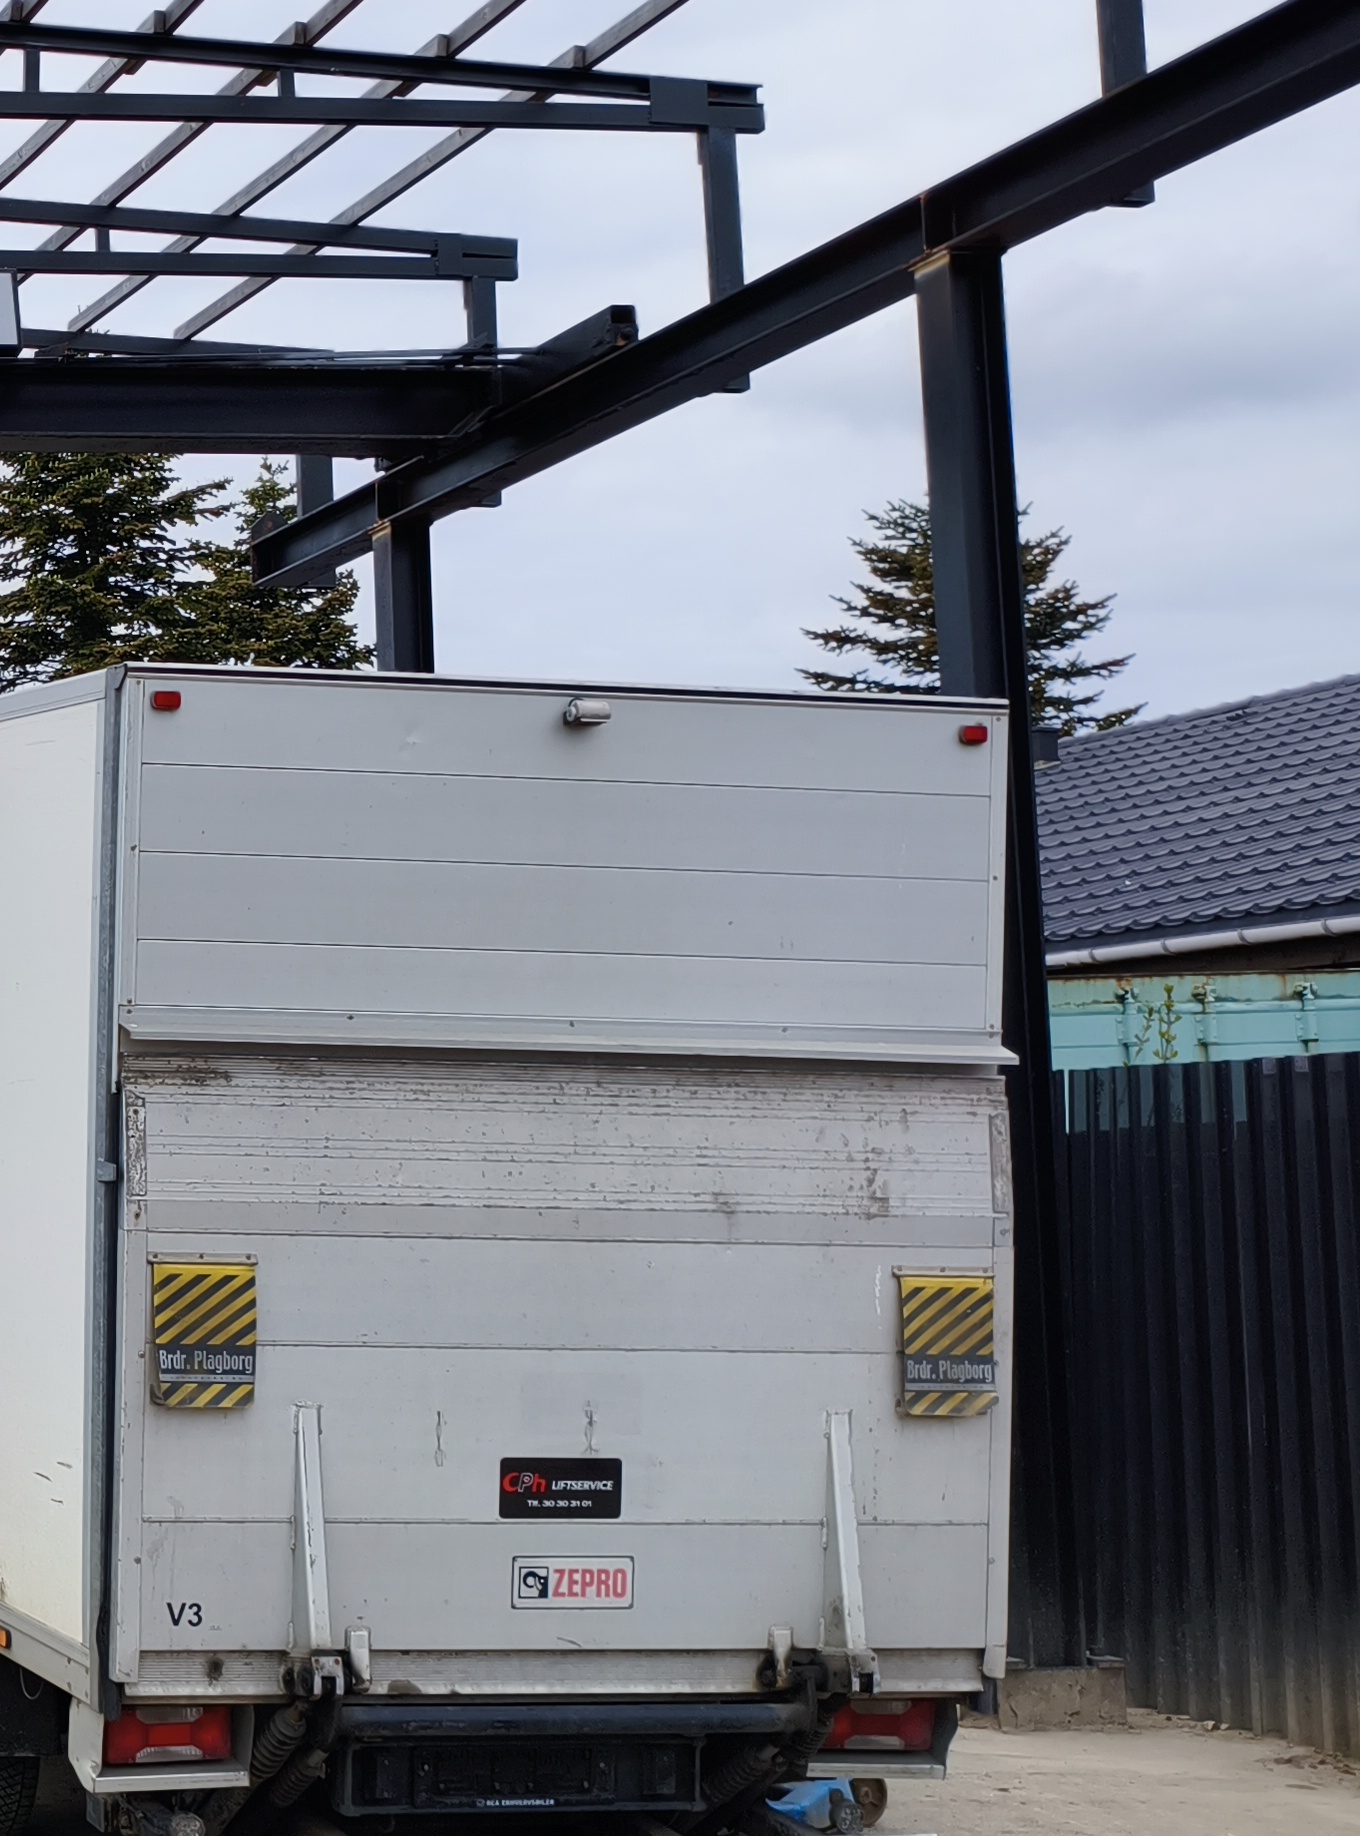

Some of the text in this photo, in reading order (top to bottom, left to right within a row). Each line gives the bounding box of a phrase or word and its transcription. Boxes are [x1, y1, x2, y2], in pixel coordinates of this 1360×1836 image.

[159, 1350, 253, 1373] Brdr. Plagborg
[907, 1360, 993, 1382] Brdr. Plagborg
[552, 1481, 614, 1490] LIFTSERVICE
[552, 1568, 627, 1599] ZEPRO
[166, 1602, 203, 1627] V3
